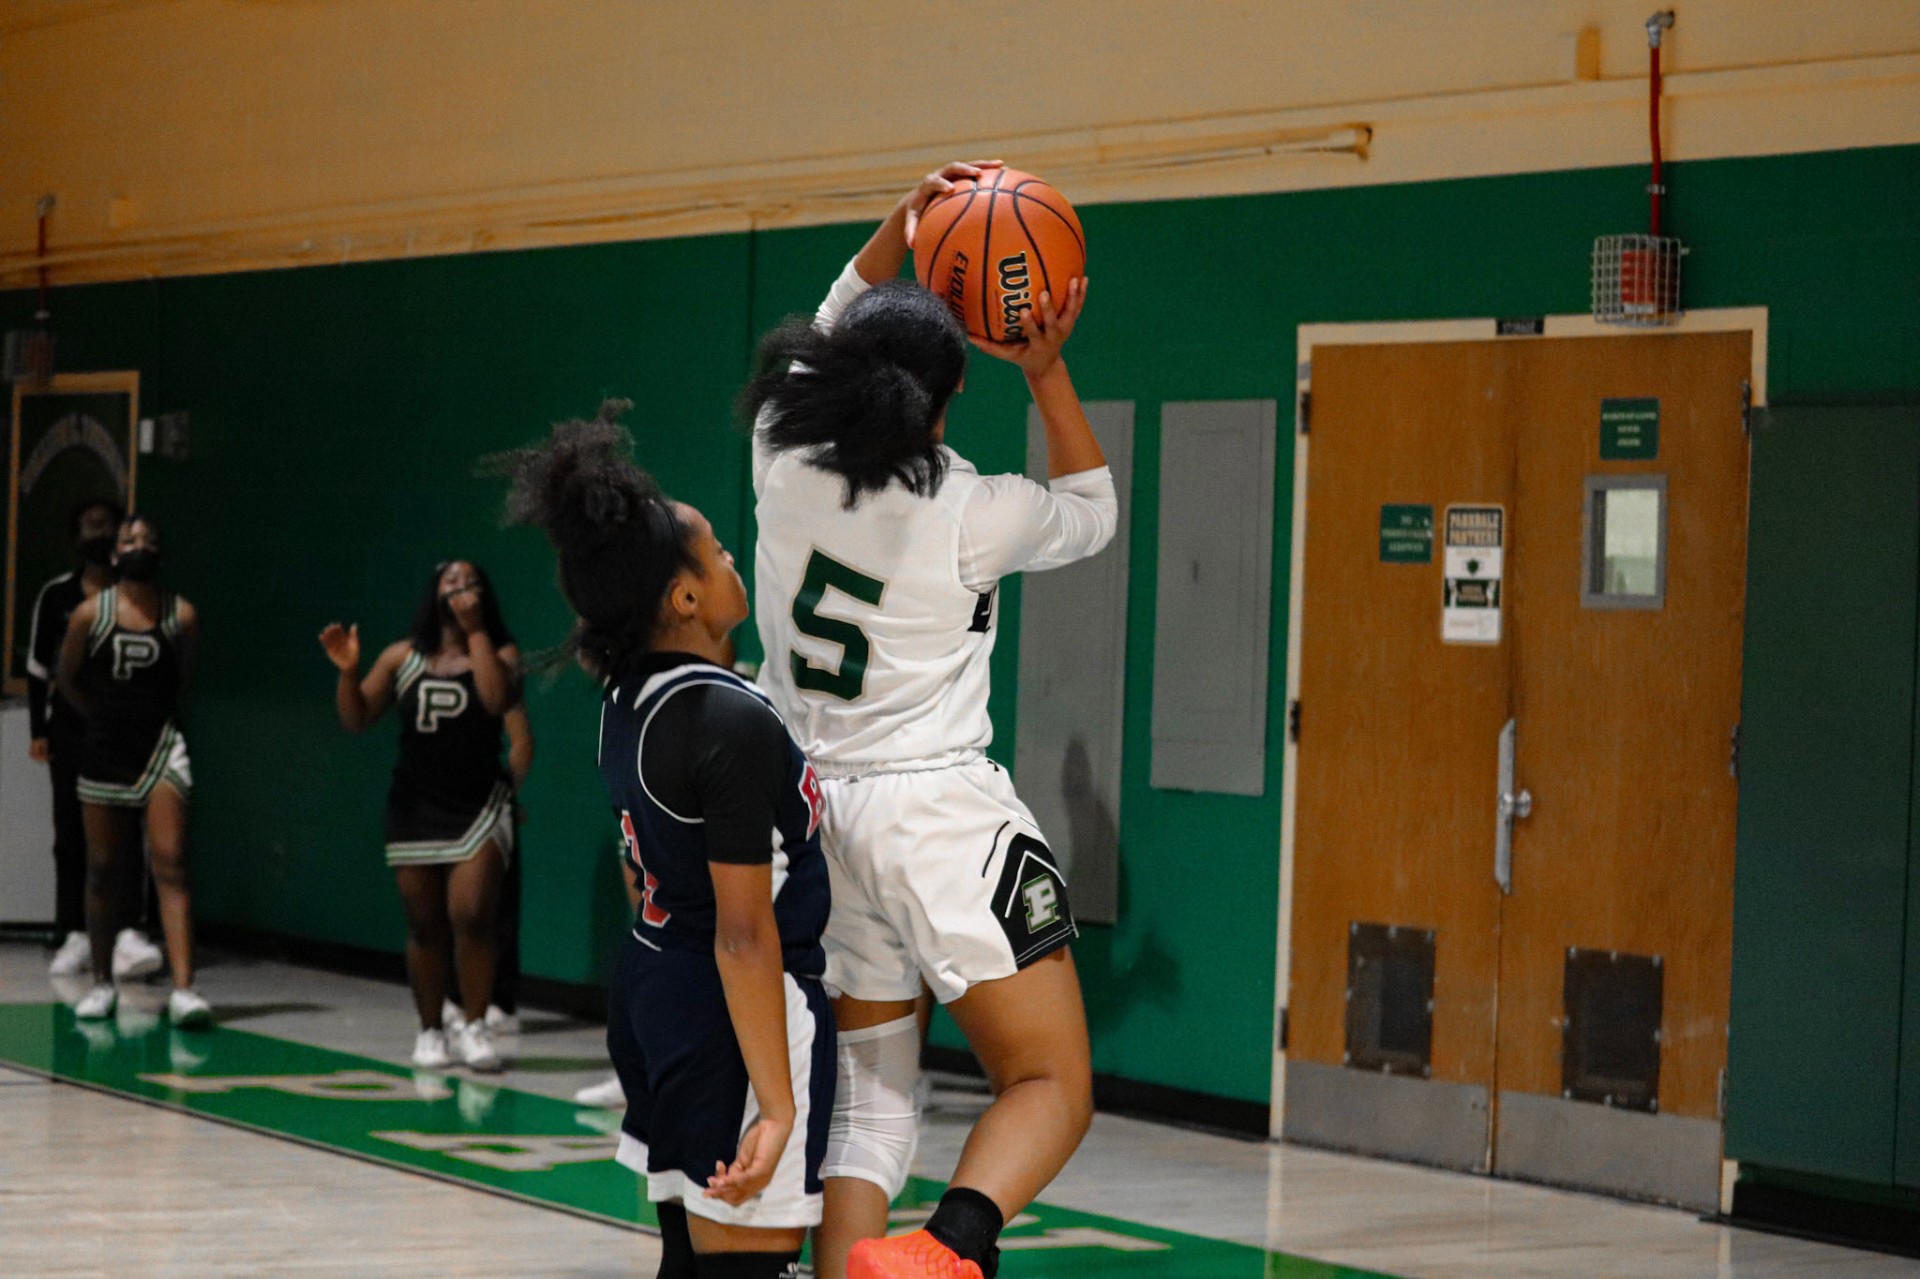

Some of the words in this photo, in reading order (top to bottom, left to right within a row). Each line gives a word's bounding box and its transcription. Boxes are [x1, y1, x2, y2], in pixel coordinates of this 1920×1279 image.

[997, 250, 1033, 341] Wilso
[789, 545, 889, 703] 5
[113, 633, 160, 681] P
[416, 680, 469, 734] P
[1021, 873, 1063, 935] P
